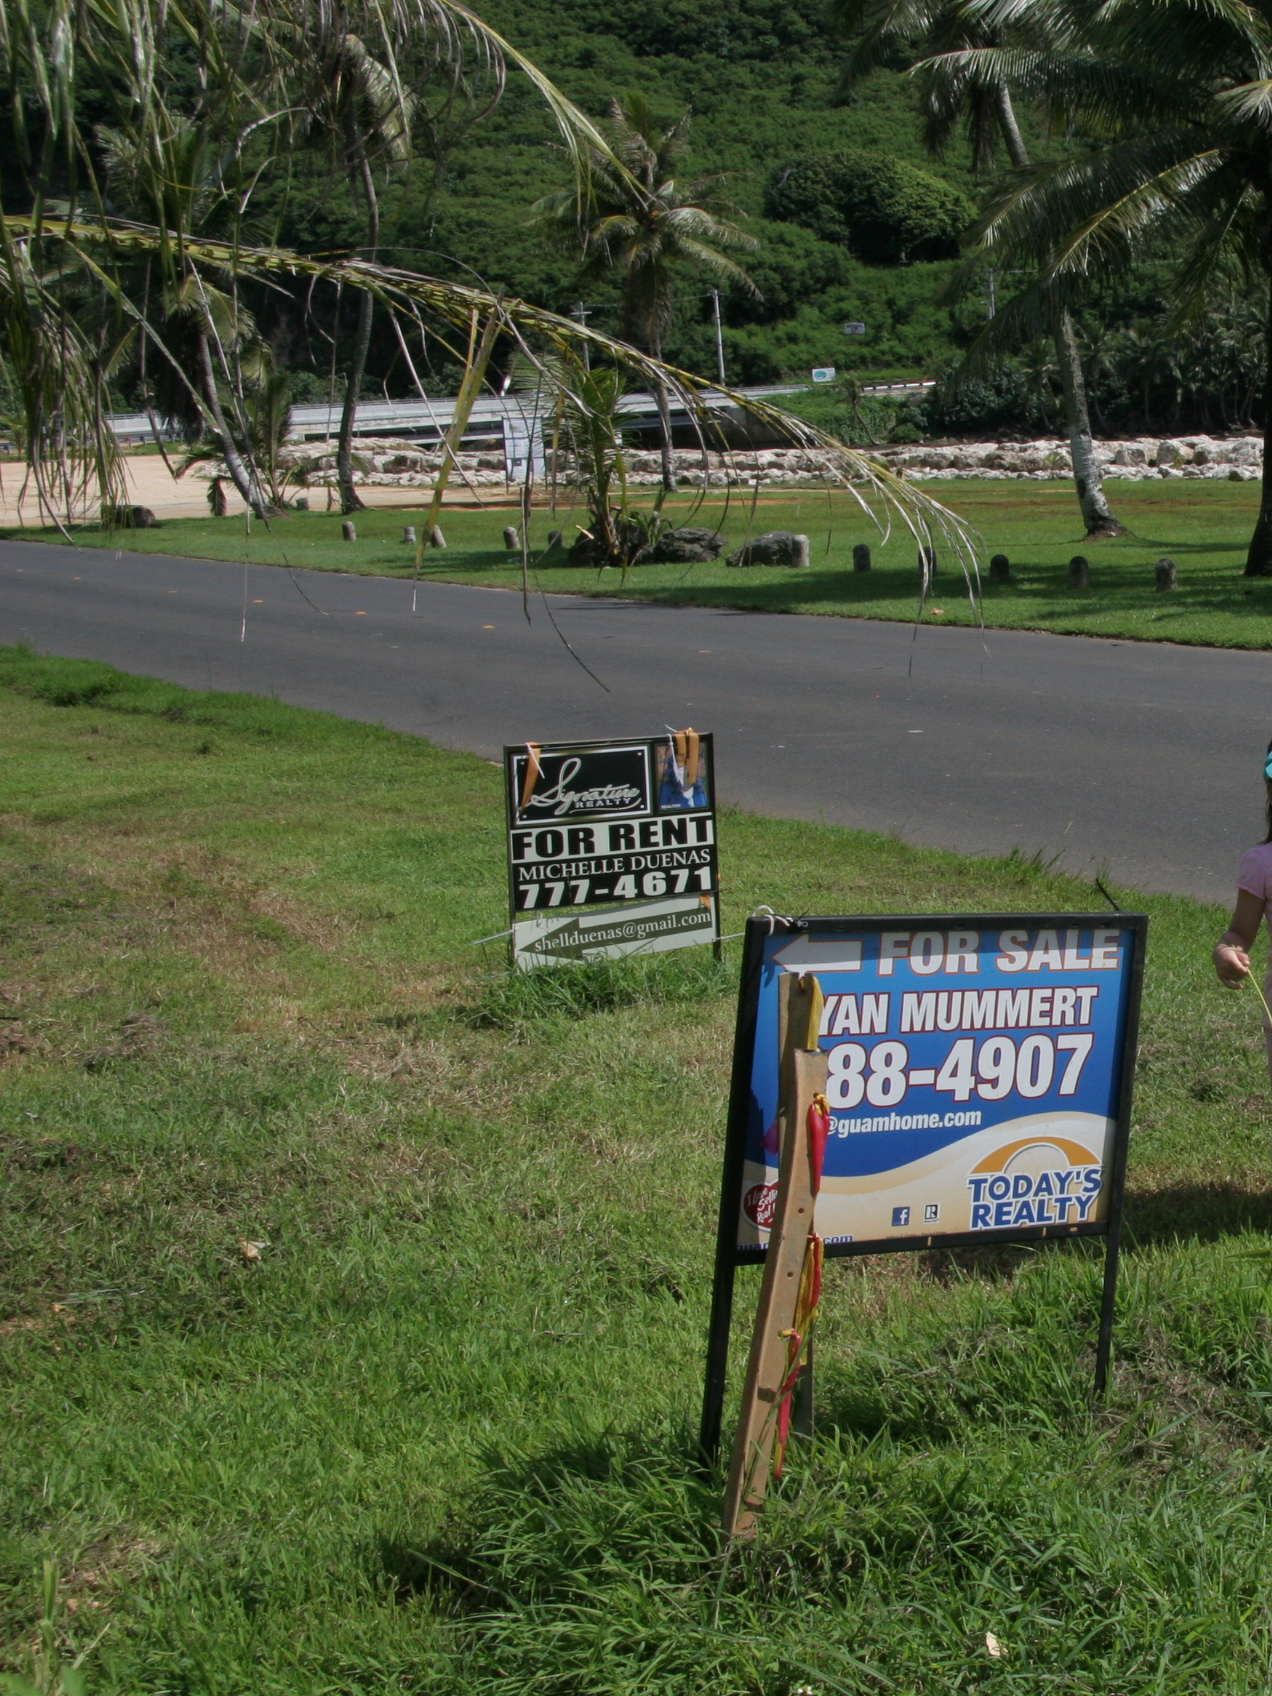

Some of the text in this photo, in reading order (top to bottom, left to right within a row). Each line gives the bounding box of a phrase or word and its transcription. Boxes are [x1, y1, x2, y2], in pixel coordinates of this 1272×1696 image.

[528, 757, 640, 815] Signature
[575, 797, 631, 809] REALTY
[512, 816, 714, 861] FOR RENT
[518, 848, 711, 882] MICHELLE DUENAS
[519, 866, 712, 909] 777-4671
[534, 910, 711, 952] shellduenas@gmail.com
[878, 930, 1120, 975] FOR SALE
[901, 986, 1098, 1033] MUMMERT
[819, 1033, 1095, 1109] 88-4907
[968, 1168, 1102, 1203] TODAY'S
[971, 1194, 1094, 1229] REALTY
